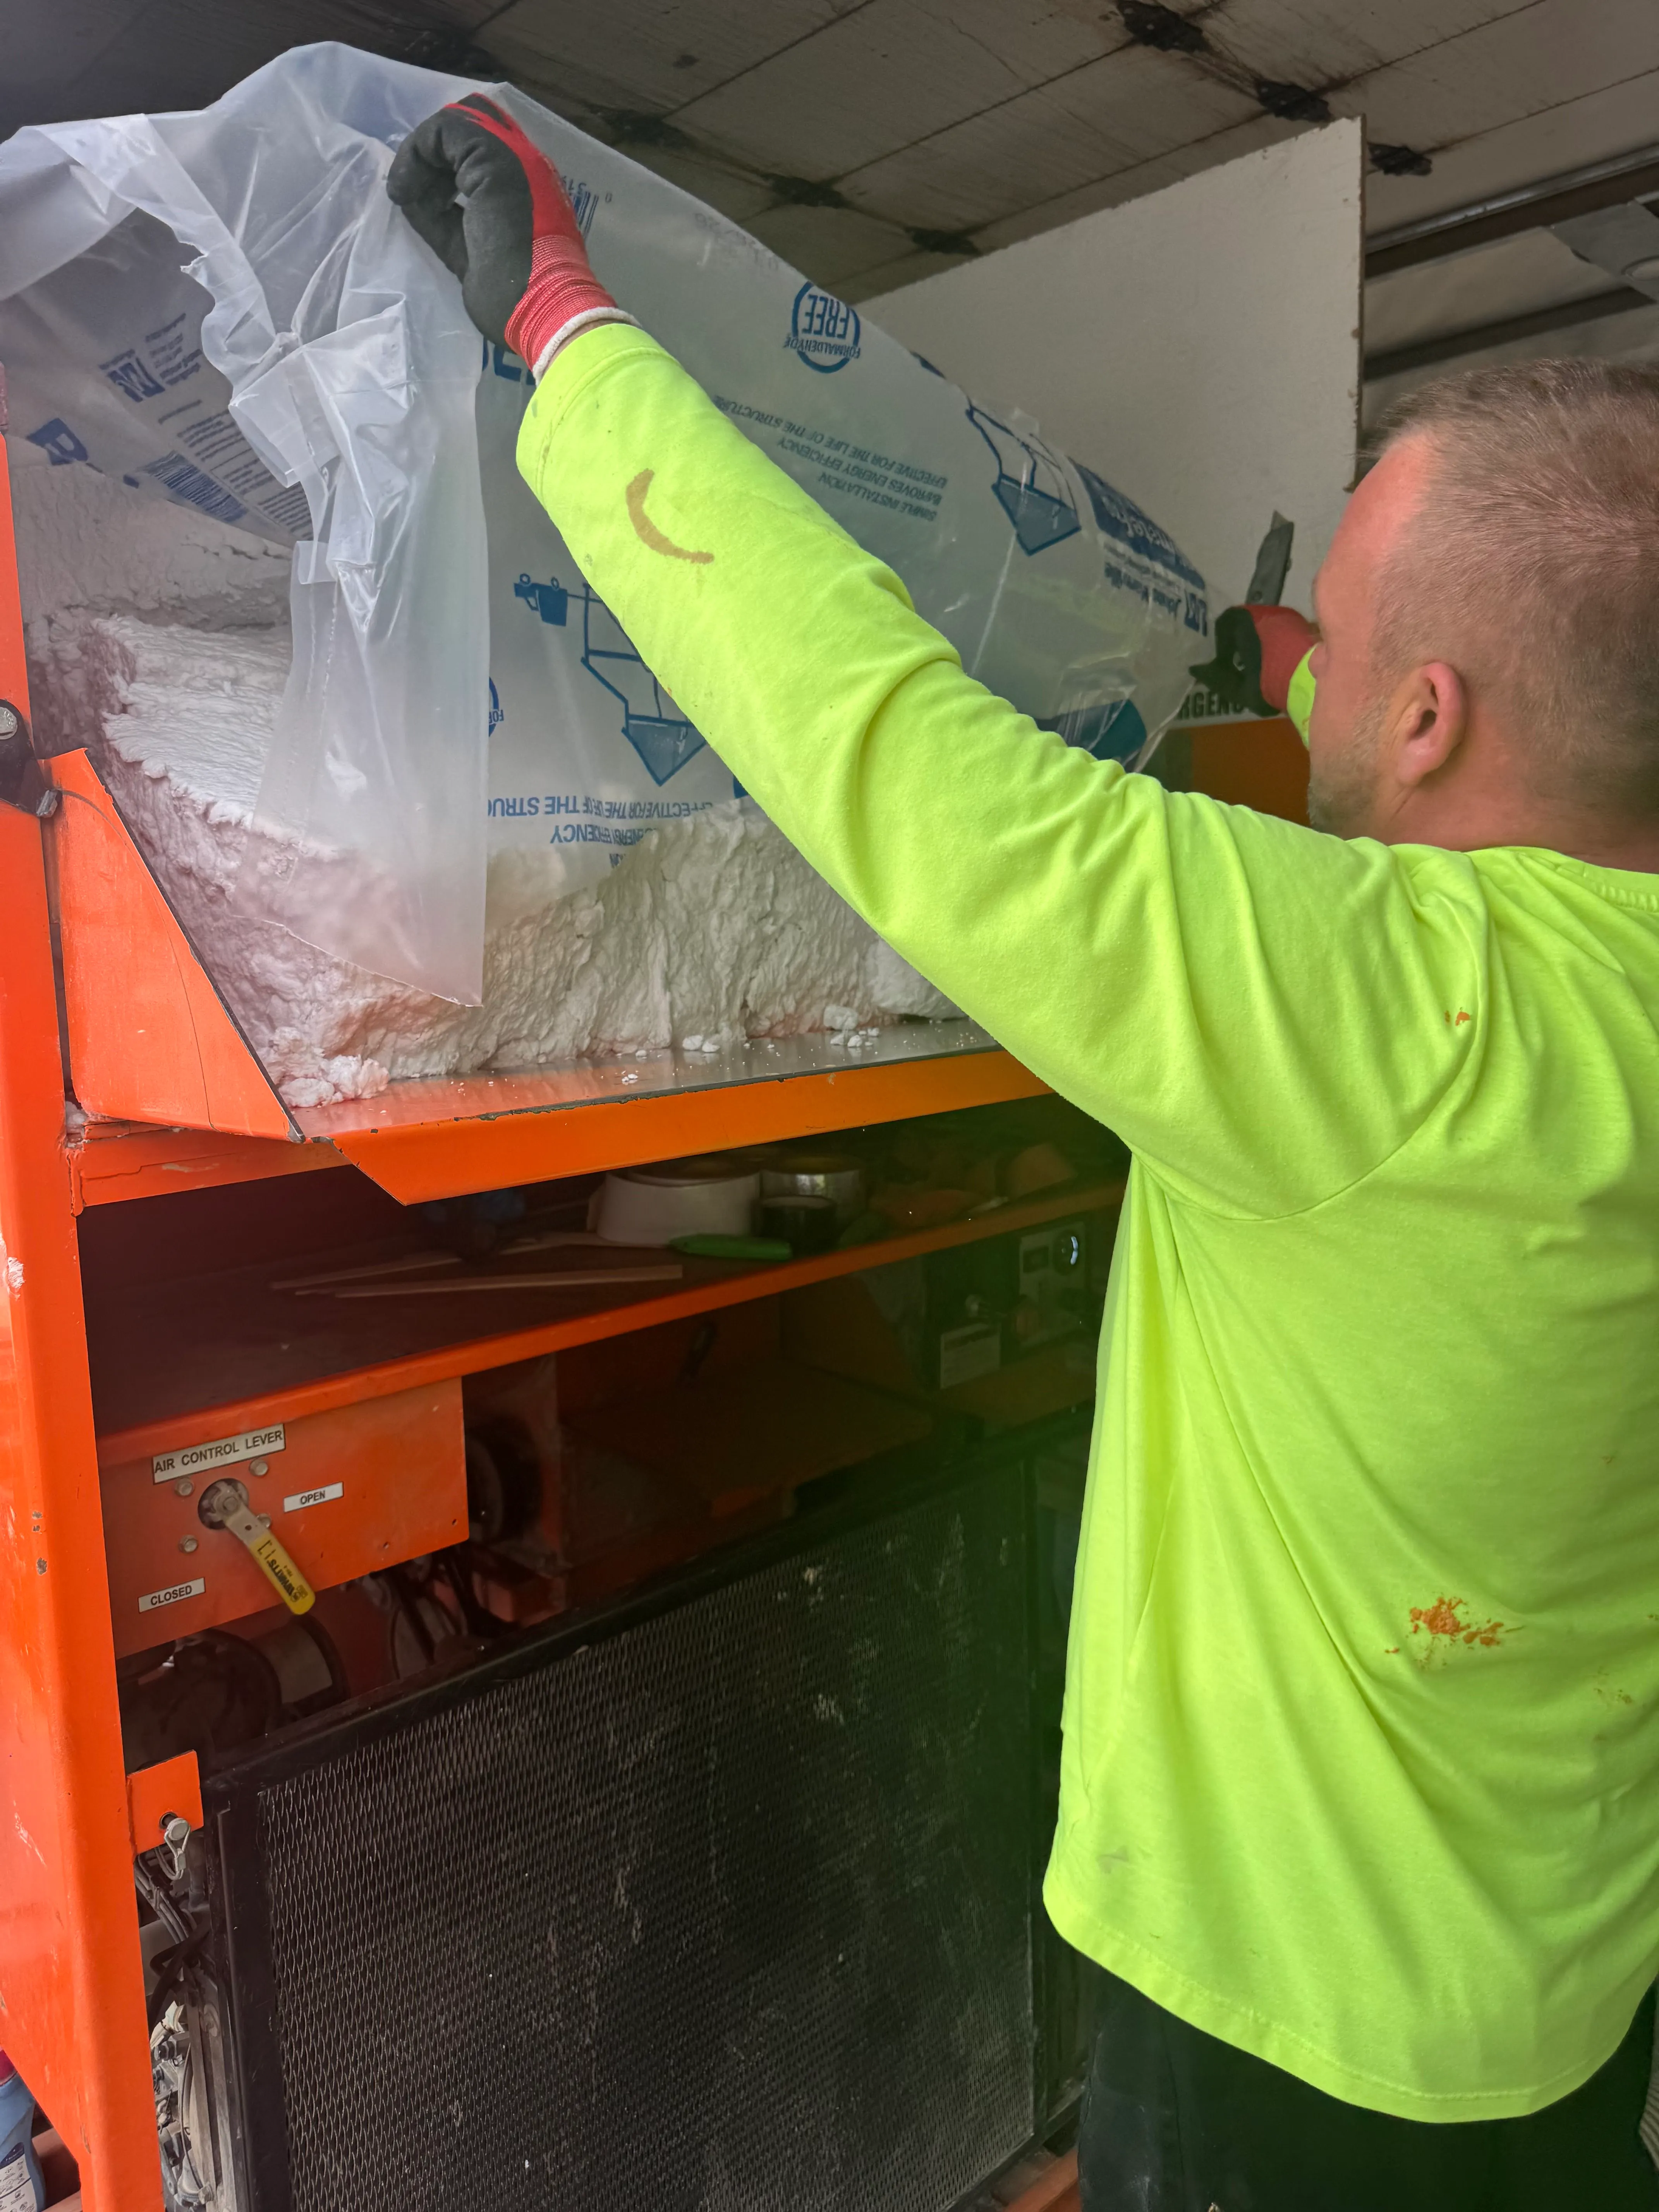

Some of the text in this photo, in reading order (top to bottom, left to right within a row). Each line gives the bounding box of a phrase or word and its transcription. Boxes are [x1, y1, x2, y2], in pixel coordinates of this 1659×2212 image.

[801, 294, 850, 340] FREE
[782, 422, 806, 437] THE
[808, 431, 825, 444] OF
[777, 437, 843, 471] EFFICIENCY
[824, 436, 850, 455] LIFE
[848, 447, 871, 462] THE
[871, 453, 896, 471] FOR
[842, 464, 888, 487] ENERGY
[894, 463, 948, 489] EFFECTIVE
[818, 472, 900, 509] INSTALLATION
[544, 796, 580, 814] THE
[605, 801, 627, 819] THE
[155, 1430, 283, 1473] AIR CONTROL LEVER
[300, 1490, 325, 1505] OPEN
[150, 1585, 192, 1606] CLOSED
